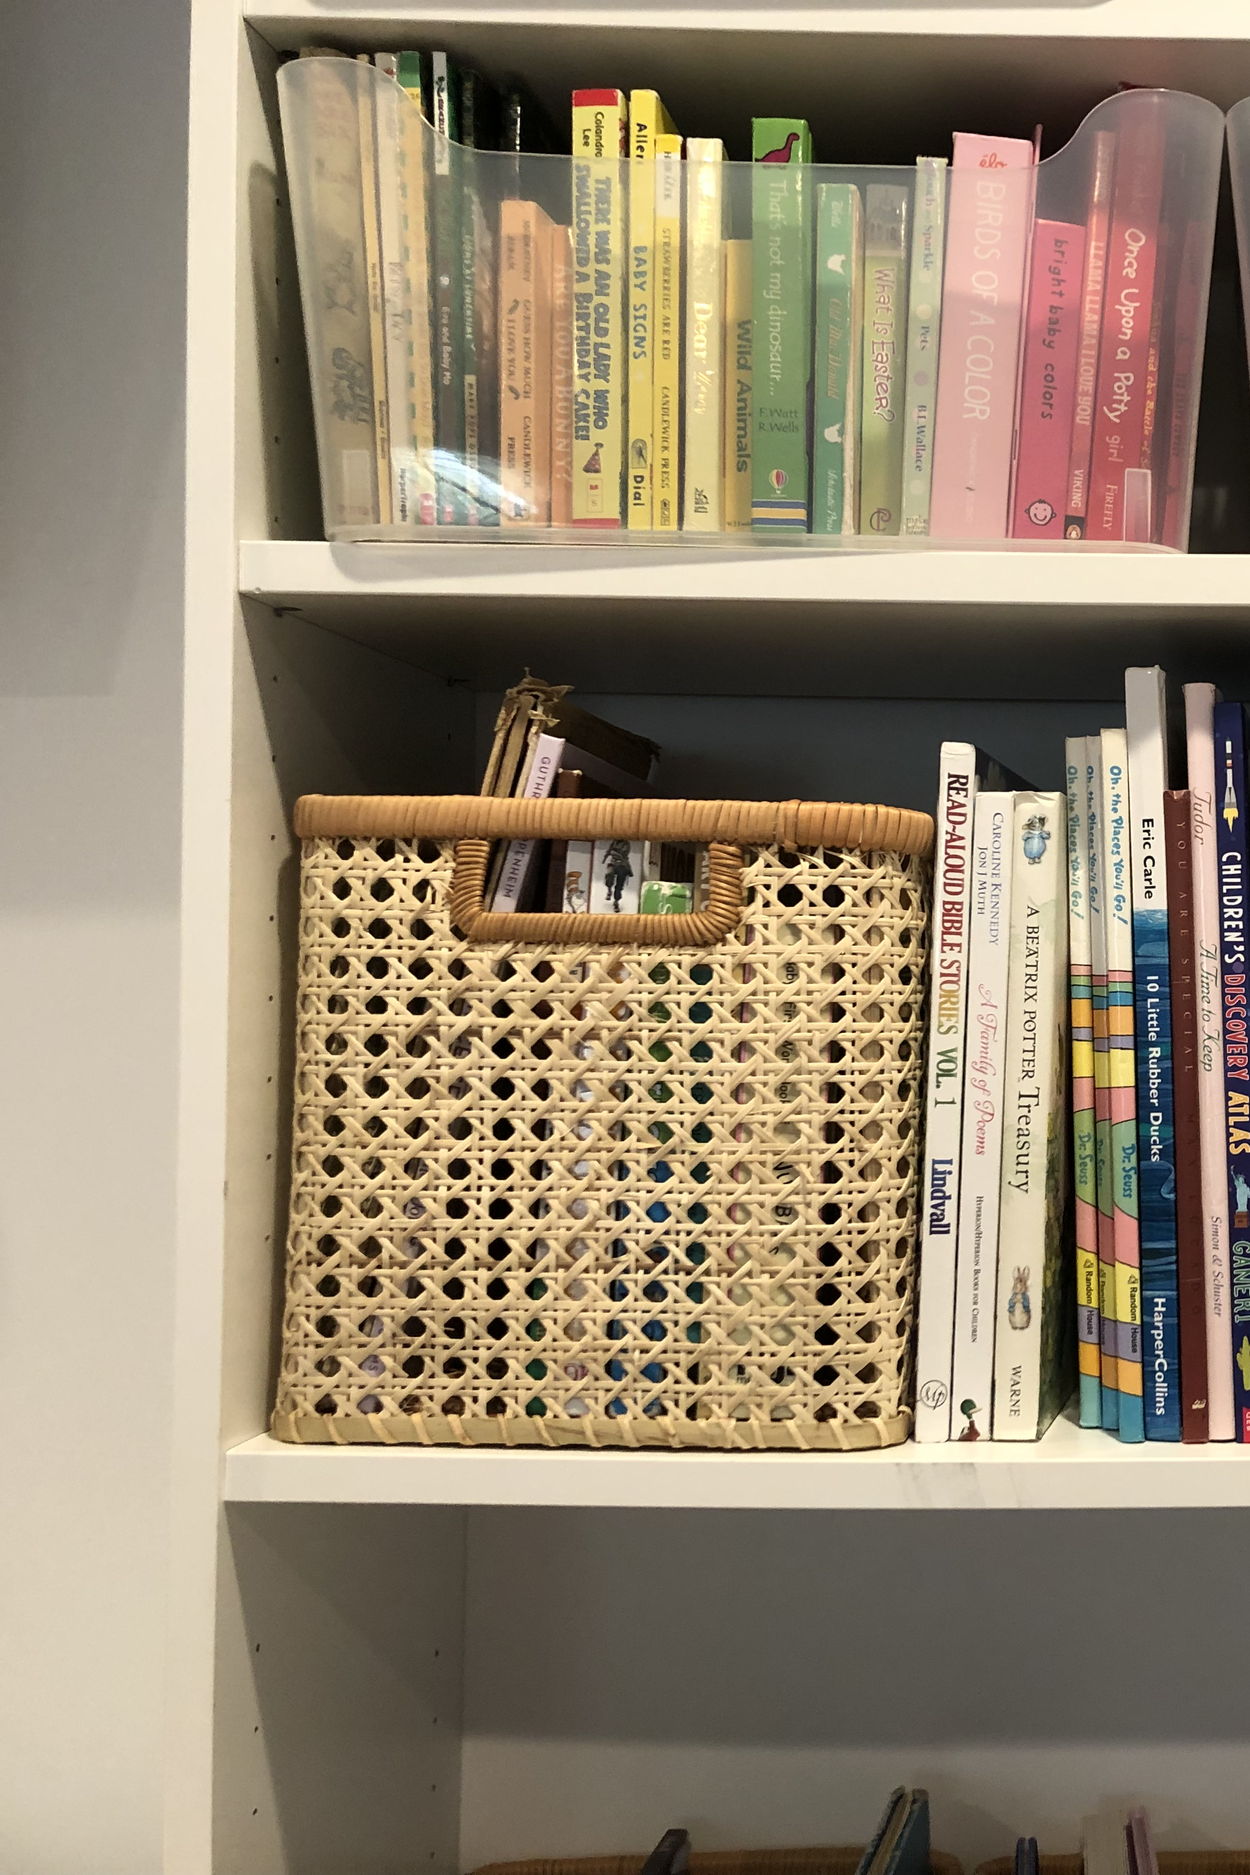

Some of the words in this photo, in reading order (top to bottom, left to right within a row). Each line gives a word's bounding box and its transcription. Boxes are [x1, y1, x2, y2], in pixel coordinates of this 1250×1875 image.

[582, 128, 592, 147] Lee
[575, 164, 593, 268] SWALLOWED
[593, 177, 611, 225] THERE
[768, 179, 787, 231] That's
[973, 180, 1007, 260] BIRDS
[594, 230, 611, 265] WAS
[633, 245, 648, 291] BABY
[768, 236, 783, 263] not
[1050, 238, 1069, 298] bright
[1122, 227, 1146, 279] Once
[576, 270, 592, 284] A
[594, 270, 611, 296] AN
[763, 267, 783, 299] my
[874, 267, 895, 314] What
[972, 271, 998, 301] OF
[594, 302, 611, 338] OLD
[632, 303, 648, 360] SIGNS
[873, 320, 893, 335] Is
[970, 310, 996, 326] A
[1043, 304, 1064, 349] baby
[1117, 288, 1141, 340] Upon
[575, 292, 593, 382] BIRTHDAY
[735, 319, 752, 371] Wild
[767, 304, 785, 396] dinosaur...
[1116, 347, 1131, 360] a
[594, 342, 611, 383] LADY
[963, 335, 994, 420] COLOR
[593, 389, 611, 430] WHO
[1041, 362, 1058, 420] colors
[1103, 371, 1133, 424] Potty
[574, 388, 593, 440] CAKE!
[735, 379, 752, 473] Animals
[1106, 434, 1123, 463] girl
[632, 474, 646, 507] Dial
[1071, 469, 1084, 508] VIKING
[1102, 484, 1118, 531] FIREFLY
[1109, 765, 1124, 792] Oh,
[1110, 793, 1123, 813] the
[1192, 791, 1213, 845] Tudor
[942, 772, 969, 896] READ-ALOUD
[990, 812, 1004, 879] CAROLINE
[1110, 815, 1124, 856] Places
[1141, 818, 1154, 850] Eric
[1112, 858, 1126, 890] You'll
[1142, 855, 1156, 900] Carle
[941, 900, 963, 954] BIBLE
[988, 882, 1003, 946] KENNEDY
[1026, 905, 1040, 918] A
[1113, 894, 1129, 926] Go!
[1221, 851, 1245, 963] CHILDREN'S
[1024, 924, 1040, 1003] BEATRIX
[1200, 942, 1218, 959] A
[936, 958, 961, 1036] STORIES
[978, 983, 998, 1010] A
[1146, 975, 1159, 992] 10
[1200, 961, 1219, 1005] Time
[1146, 998, 1160, 1041] Little
[1201, 1007, 1216, 1022] to
[1223, 973, 1250, 1080] DISCOVERY
[970, 1012, 997, 1076] Family
[1021, 1010, 1037, 1081] POTTER
[1201, 1024, 1221, 1072] Keep
[935, 1046, 958, 1089] VOL.
[973, 1078, 994, 1096] of
[1148, 1046, 1163, 1107] Rubber
[934, 1096, 957, 1108] 1
[973, 1100, 995, 1156] Poems
[1008, 1086, 1041, 1194] Treasury
[1149, 1111, 1165, 1163] Ducks
[1122, 1143, 1136, 1164] Dr.
[929, 1158, 954, 1235] Lindvall
[1121, 1166, 1137, 1199] Seuss
[1210, 1215, 1222, 1251] Simon
[1212, 1255, 1222, 1266] &
[1128, 1287, 1138, 1322] Random
[1212, 1269, 1224, 1318] Schuster
[1130, 1327, 1139, 1353] House
[1152, 1298, 1168, 1415] HarperCollins
[1009, 1364, 1023, 1417] WARNE
